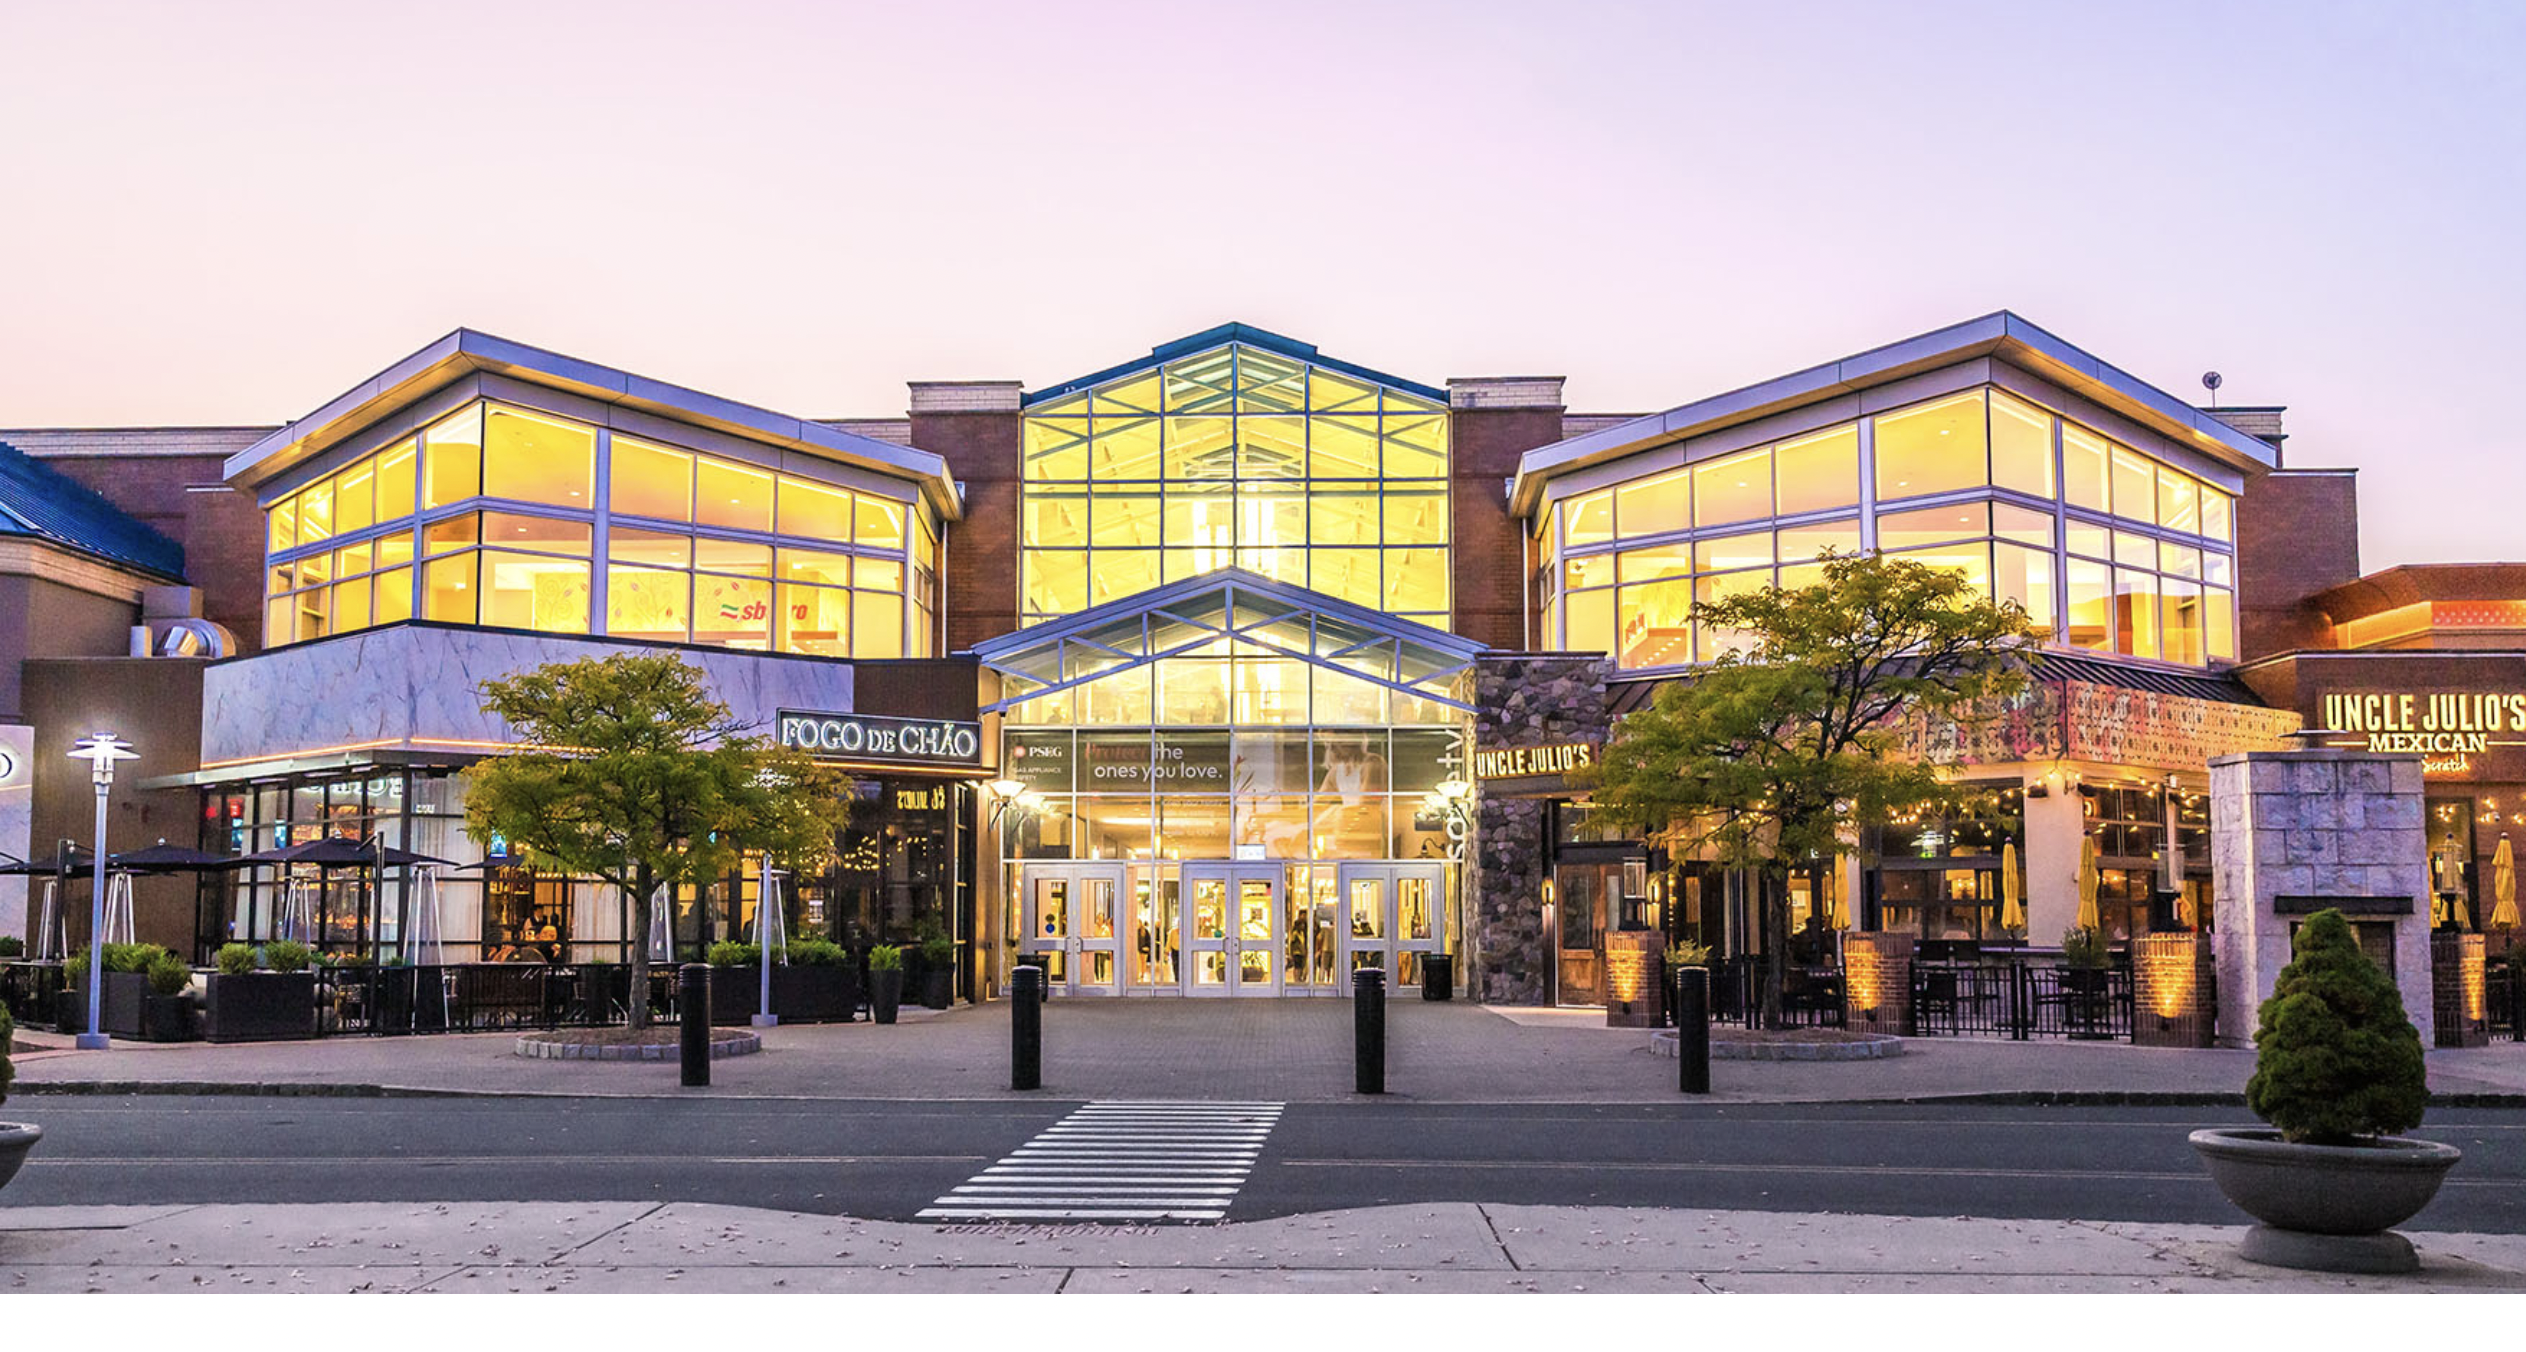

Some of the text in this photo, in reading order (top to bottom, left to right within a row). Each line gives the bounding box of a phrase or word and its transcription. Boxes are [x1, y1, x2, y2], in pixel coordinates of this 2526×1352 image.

[741, 601, 807, 620] sbro
[2325, 693, 2526, 731] UNCLE JULIO'S
[782, 718, 978, 757] FOGO DE CHÃO
[2368, 733, 2487, 753] MEXICAN
[1029, 746, 1062, 757] PSEG
[1154, 743, 1183, 760] the
[1476, 744, 1590, 777] UNCLE JULIO'S
[1094, 762, 1222, 782] ones you love.
